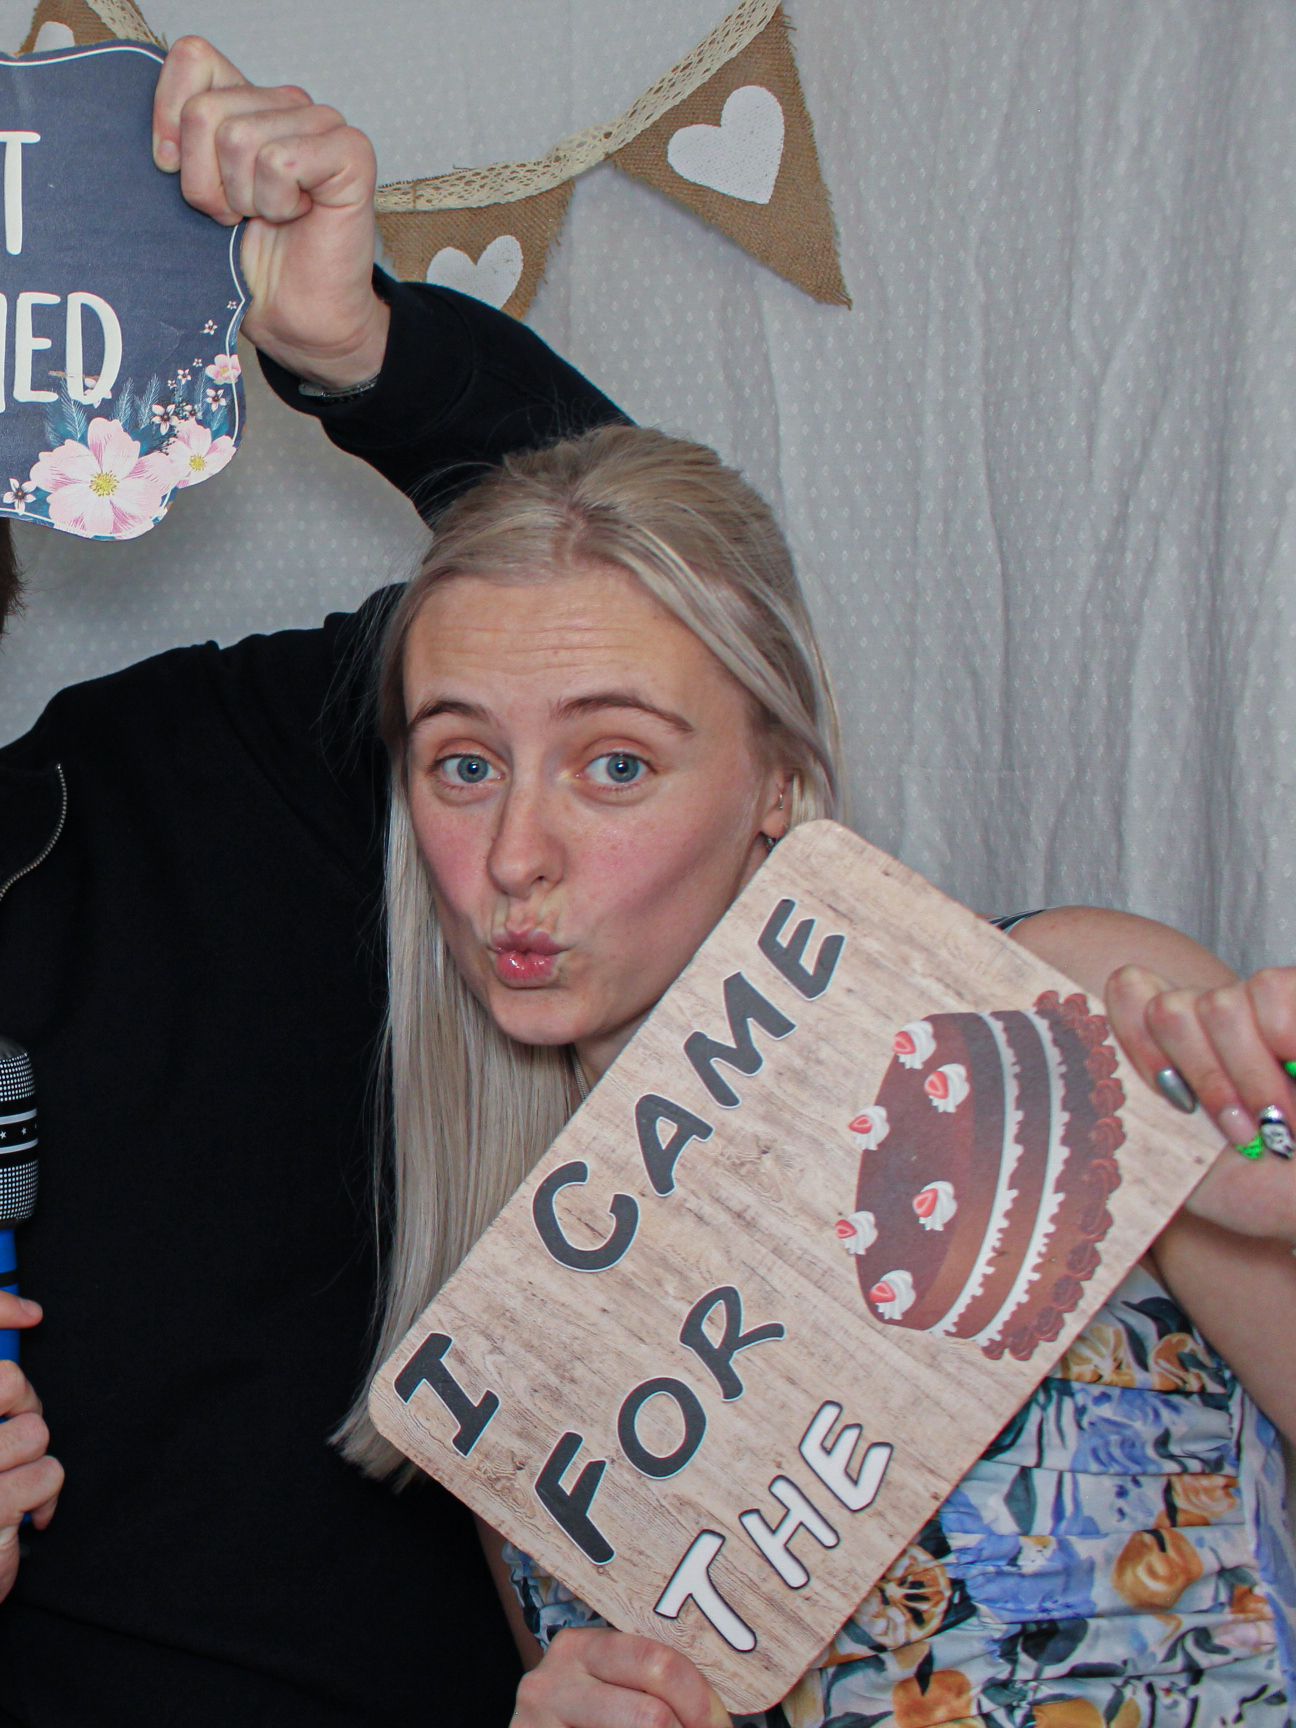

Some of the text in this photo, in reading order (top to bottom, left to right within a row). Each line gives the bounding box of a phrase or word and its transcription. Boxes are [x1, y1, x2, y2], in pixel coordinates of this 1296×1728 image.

[396, 899, 845, 1457] I CAME
[534, 1286, 784, 1564] FOR
[654, 1401, 893, 1651] THE
